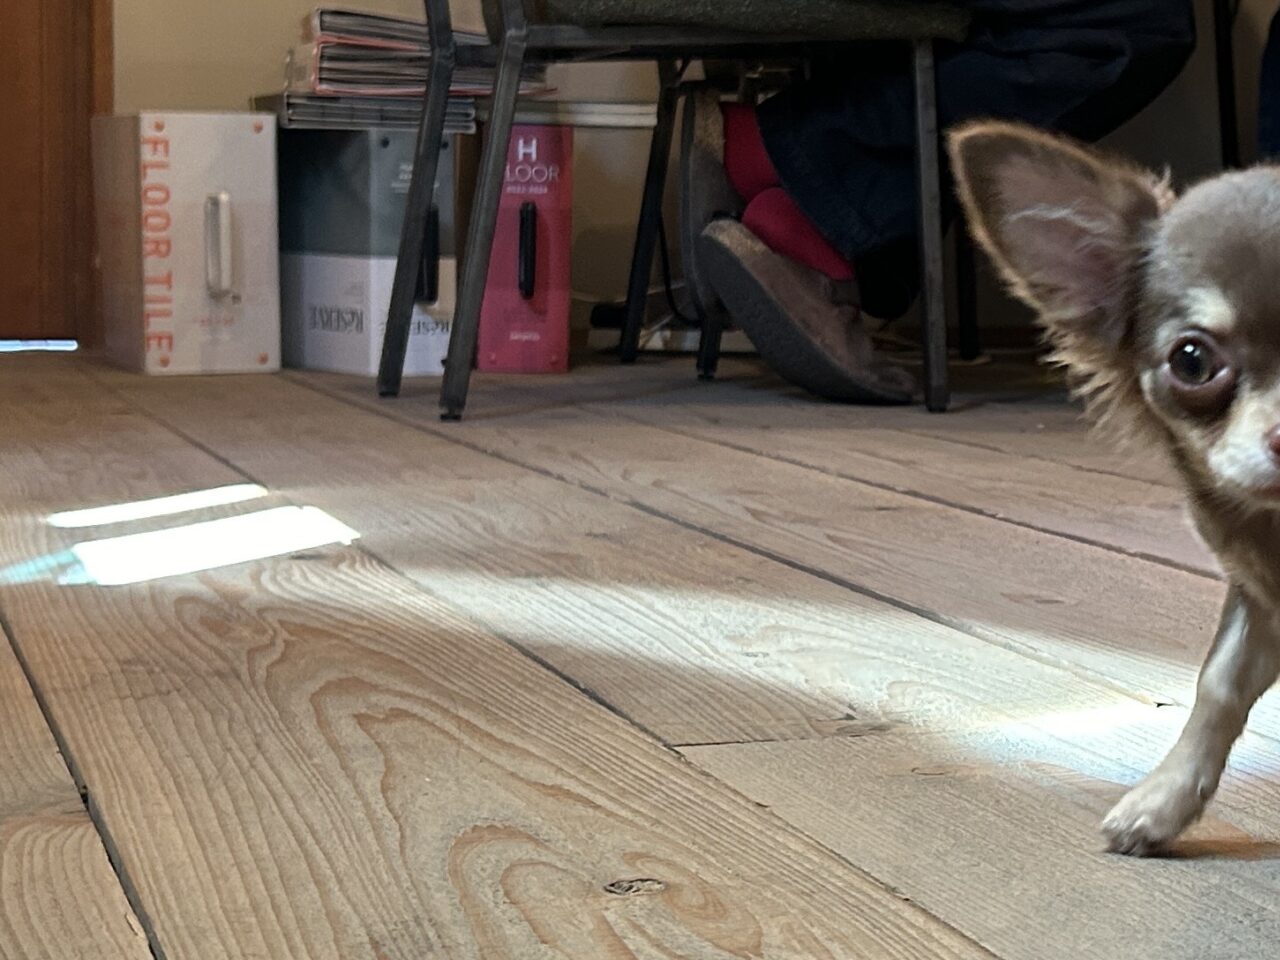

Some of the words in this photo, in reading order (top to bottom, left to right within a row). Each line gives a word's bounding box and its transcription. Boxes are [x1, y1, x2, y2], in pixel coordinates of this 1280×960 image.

[505, 164, 560, 183] LOOR
[518, 138, 538, 162] H
[141, 136, 171, 259] FLOOR
[144, 271, 173, 353] TILE
